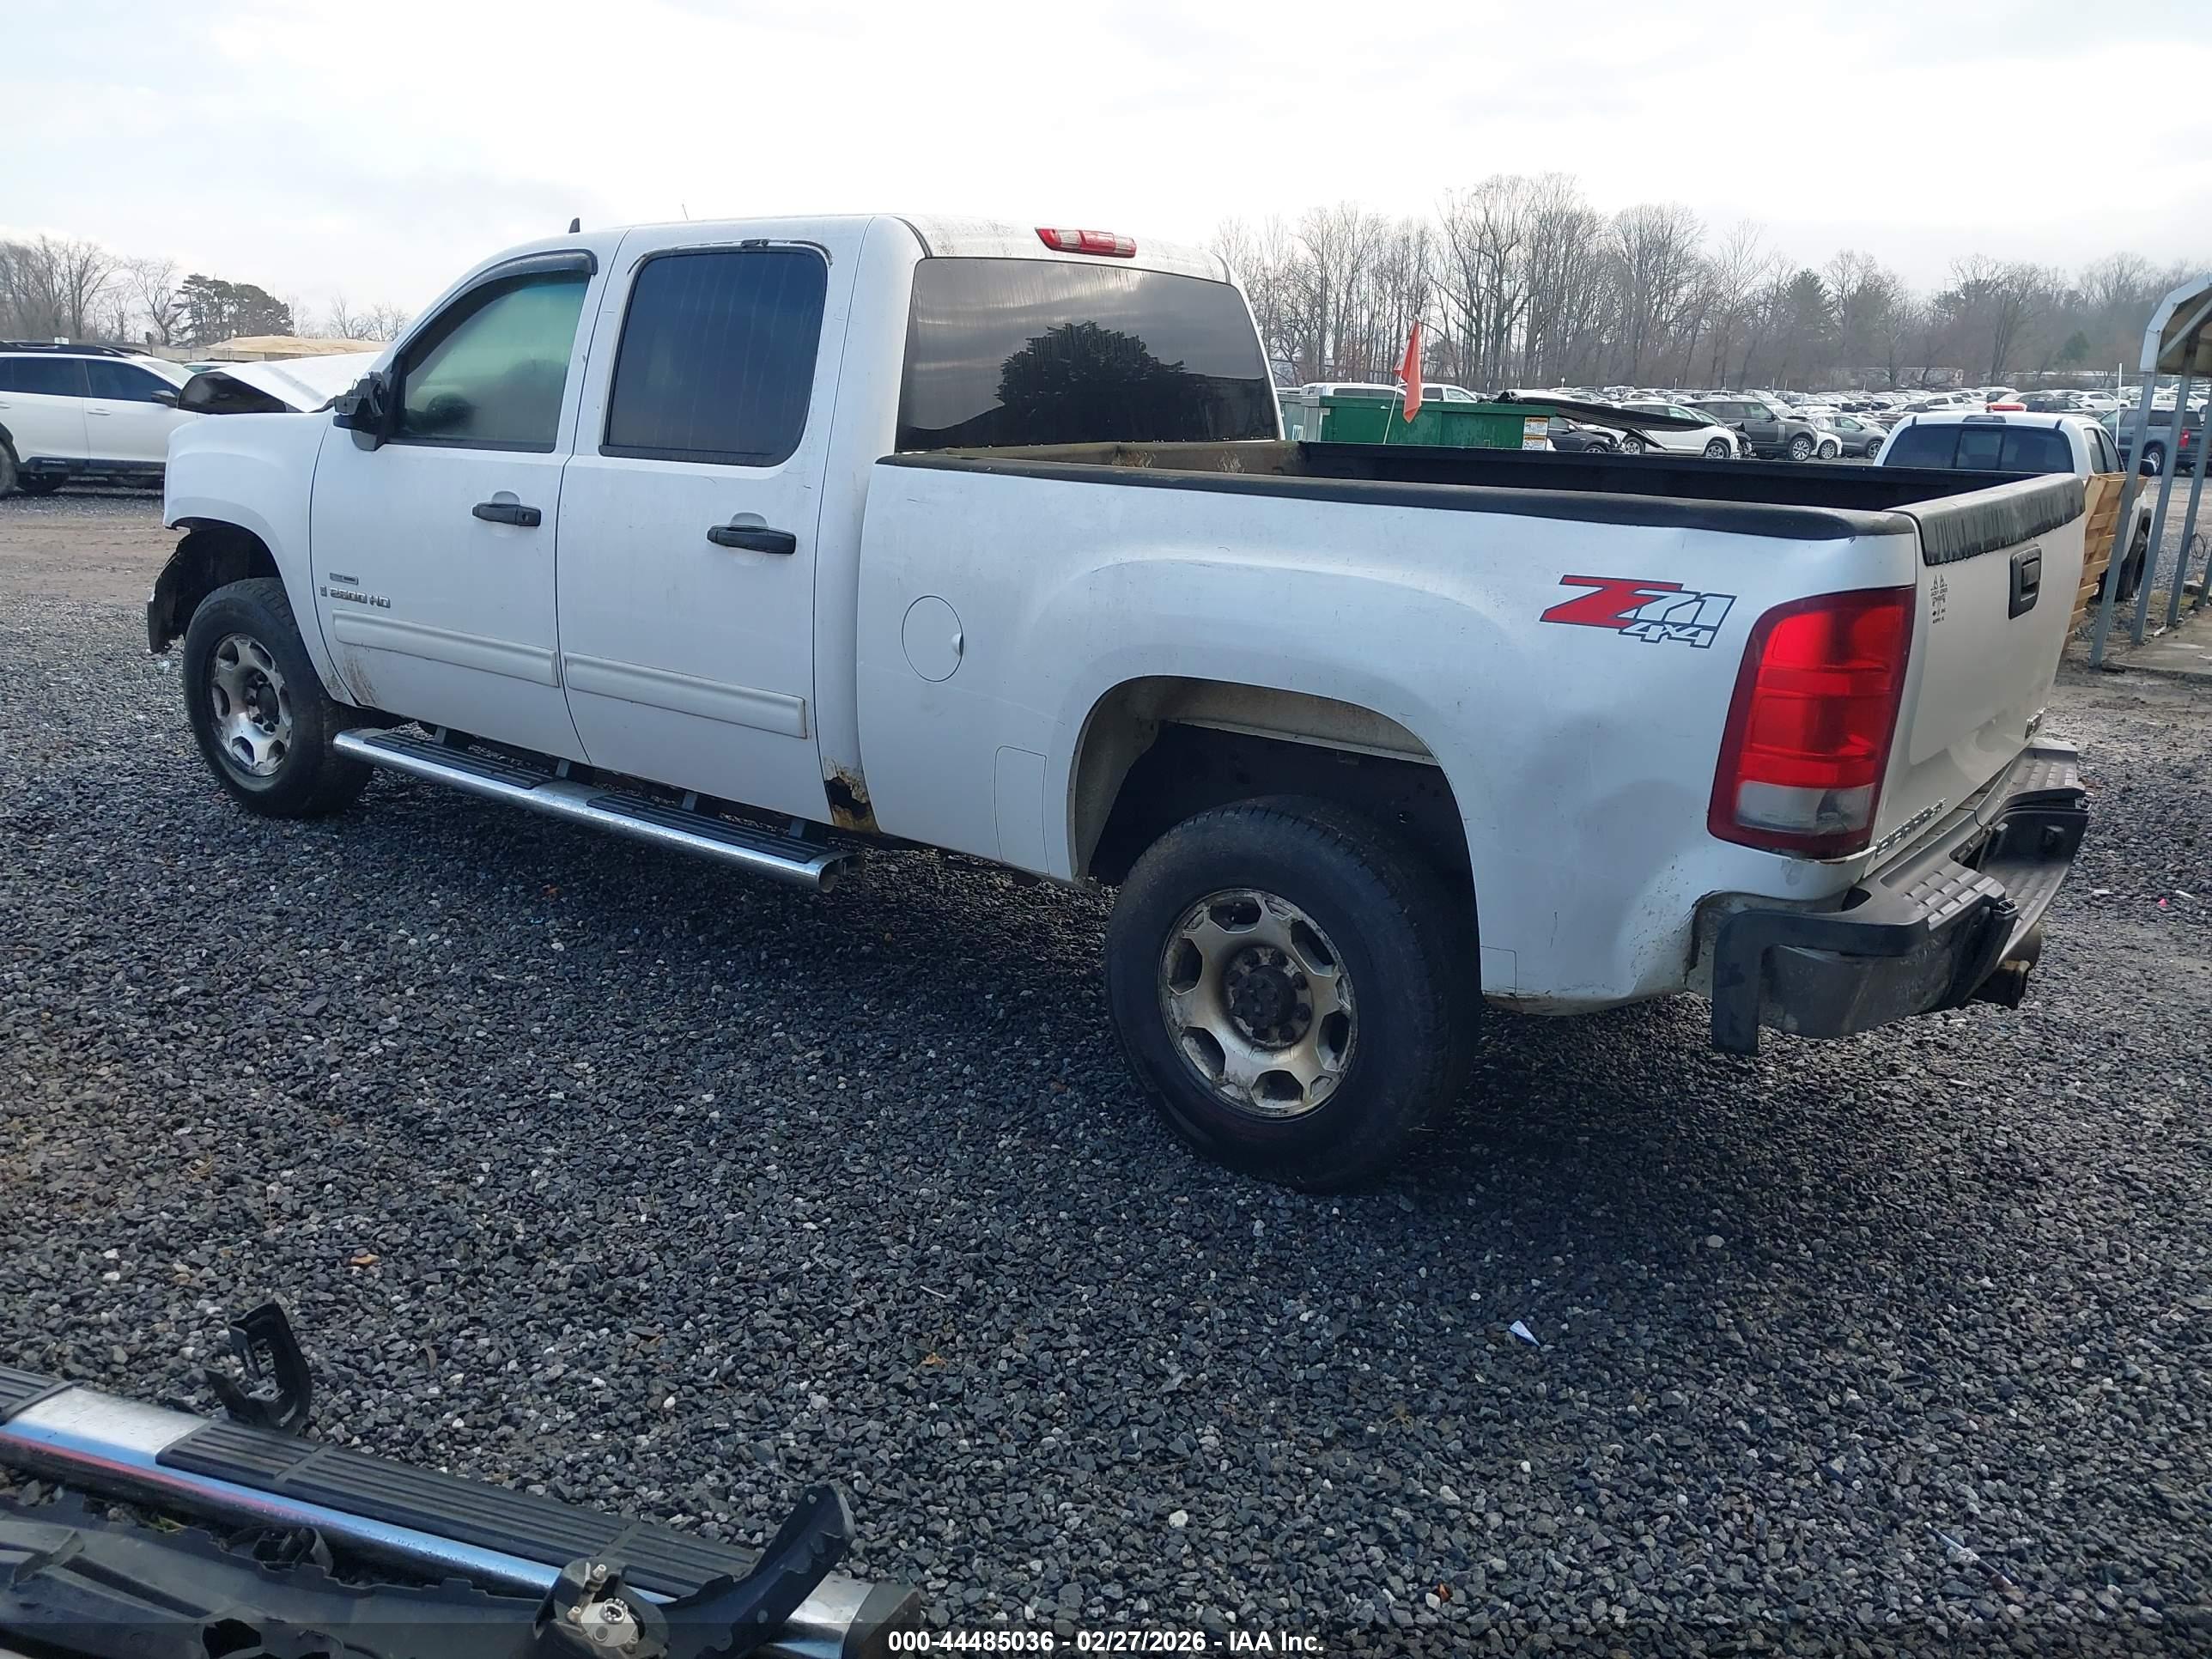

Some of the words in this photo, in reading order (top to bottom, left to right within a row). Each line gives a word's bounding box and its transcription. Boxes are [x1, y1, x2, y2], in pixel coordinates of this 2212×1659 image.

[330, 587, 368, 604] 2500
[369, 594, 391, 608] HD
[1540, 574, 1737, 629] Z71
